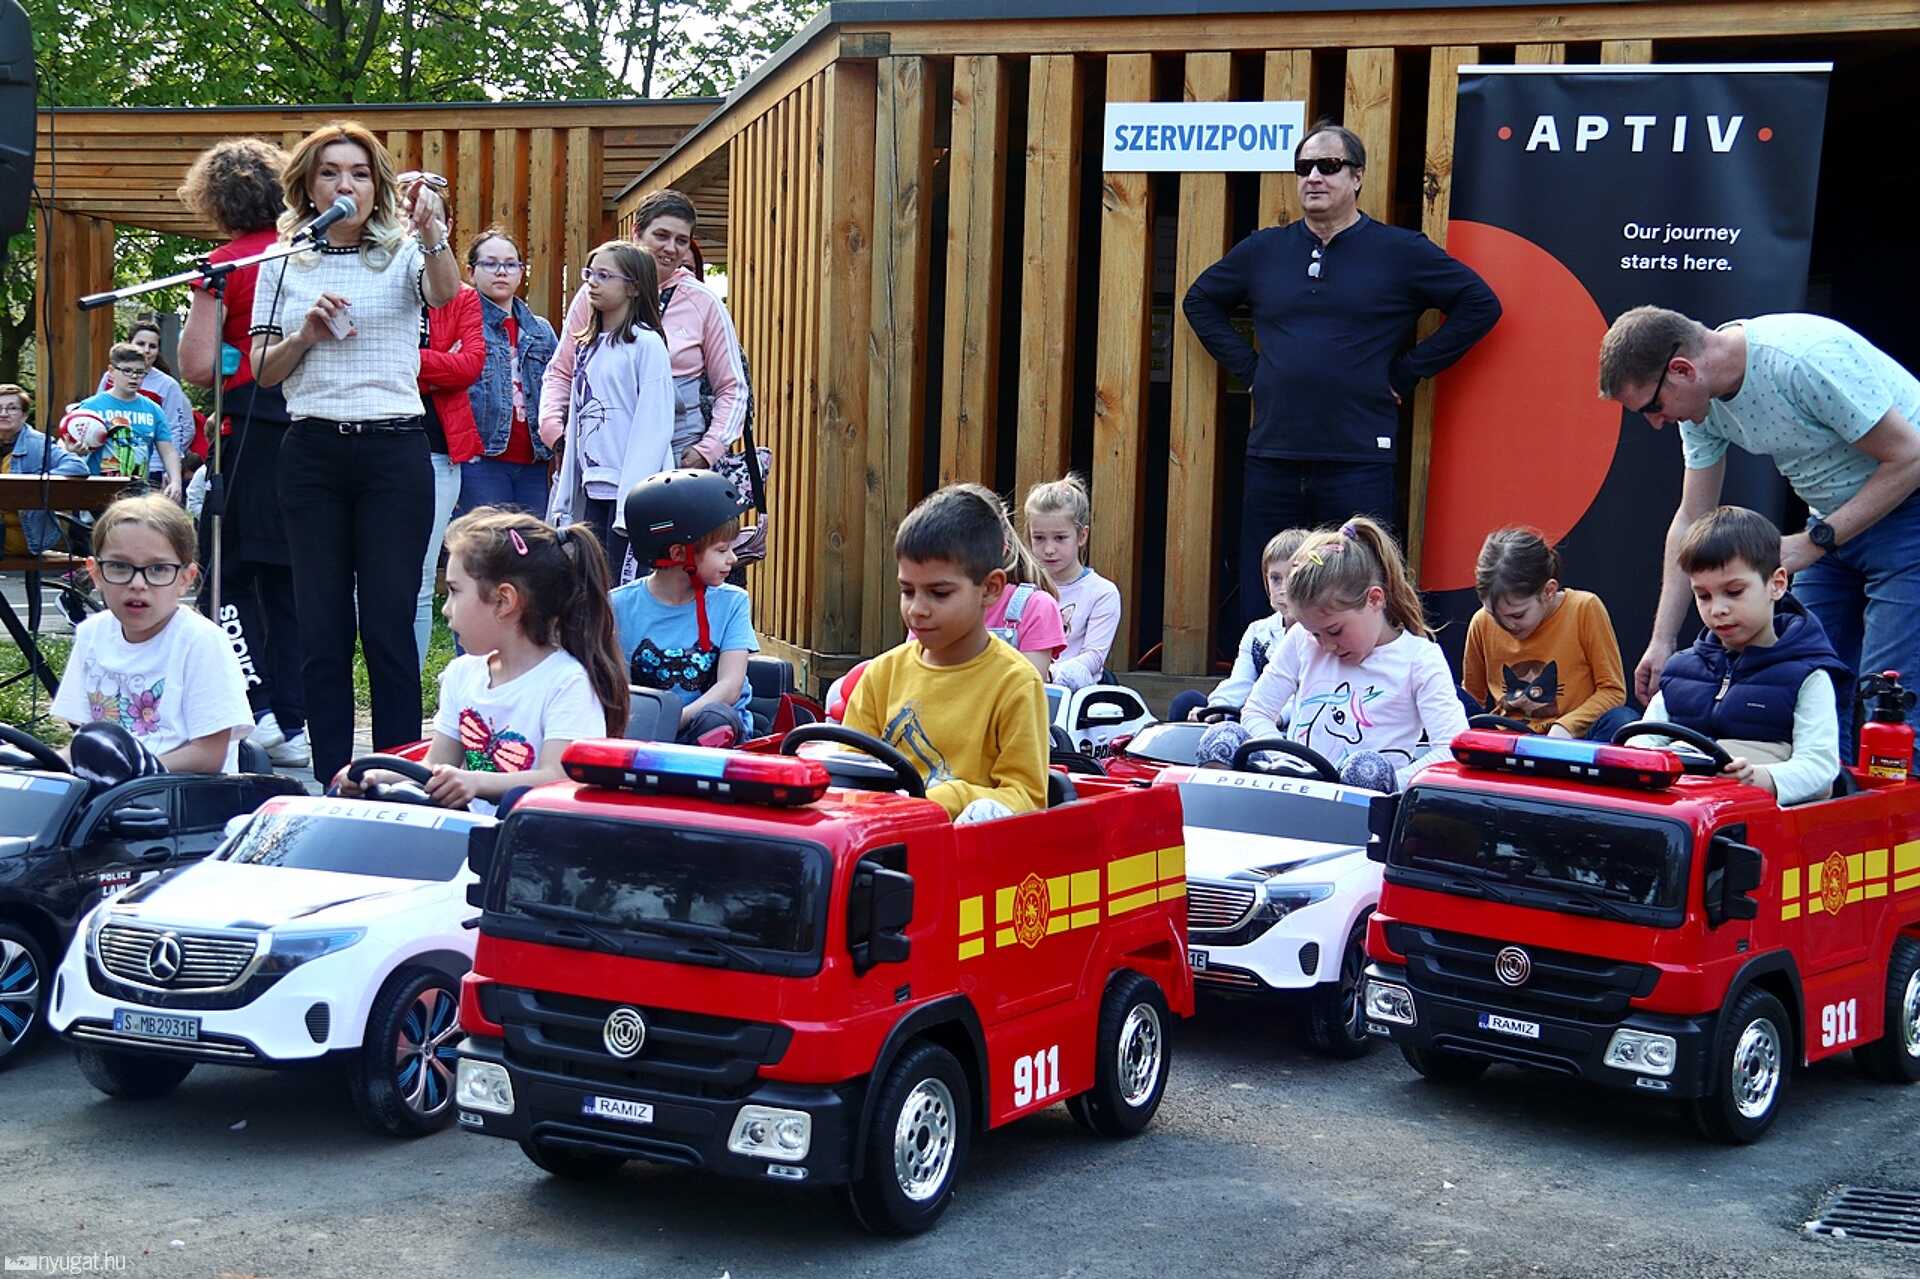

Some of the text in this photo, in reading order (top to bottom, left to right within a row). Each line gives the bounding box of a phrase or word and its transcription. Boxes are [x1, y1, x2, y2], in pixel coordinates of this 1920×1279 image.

[1114, 124, 1295, 151] SZERVIZPONT
[1525, 115, 1744, 152] APTIV
[1623, 222, 1742, 244] Our journey
[1620, 253, 1732, 271] starts here.
[1216, 775, 1310, 794] POLICE
[313, 804, 409, 821] POLICE
[99, 871, 131, 882] POLICE
[1492, 1017, 1534, 1036] RAMIZ
[1822, 998, 1857, 1048] 911
[1014, 1044, 1060, 1108] 911
[600, 1099, 648, 1118] RAMIZ
